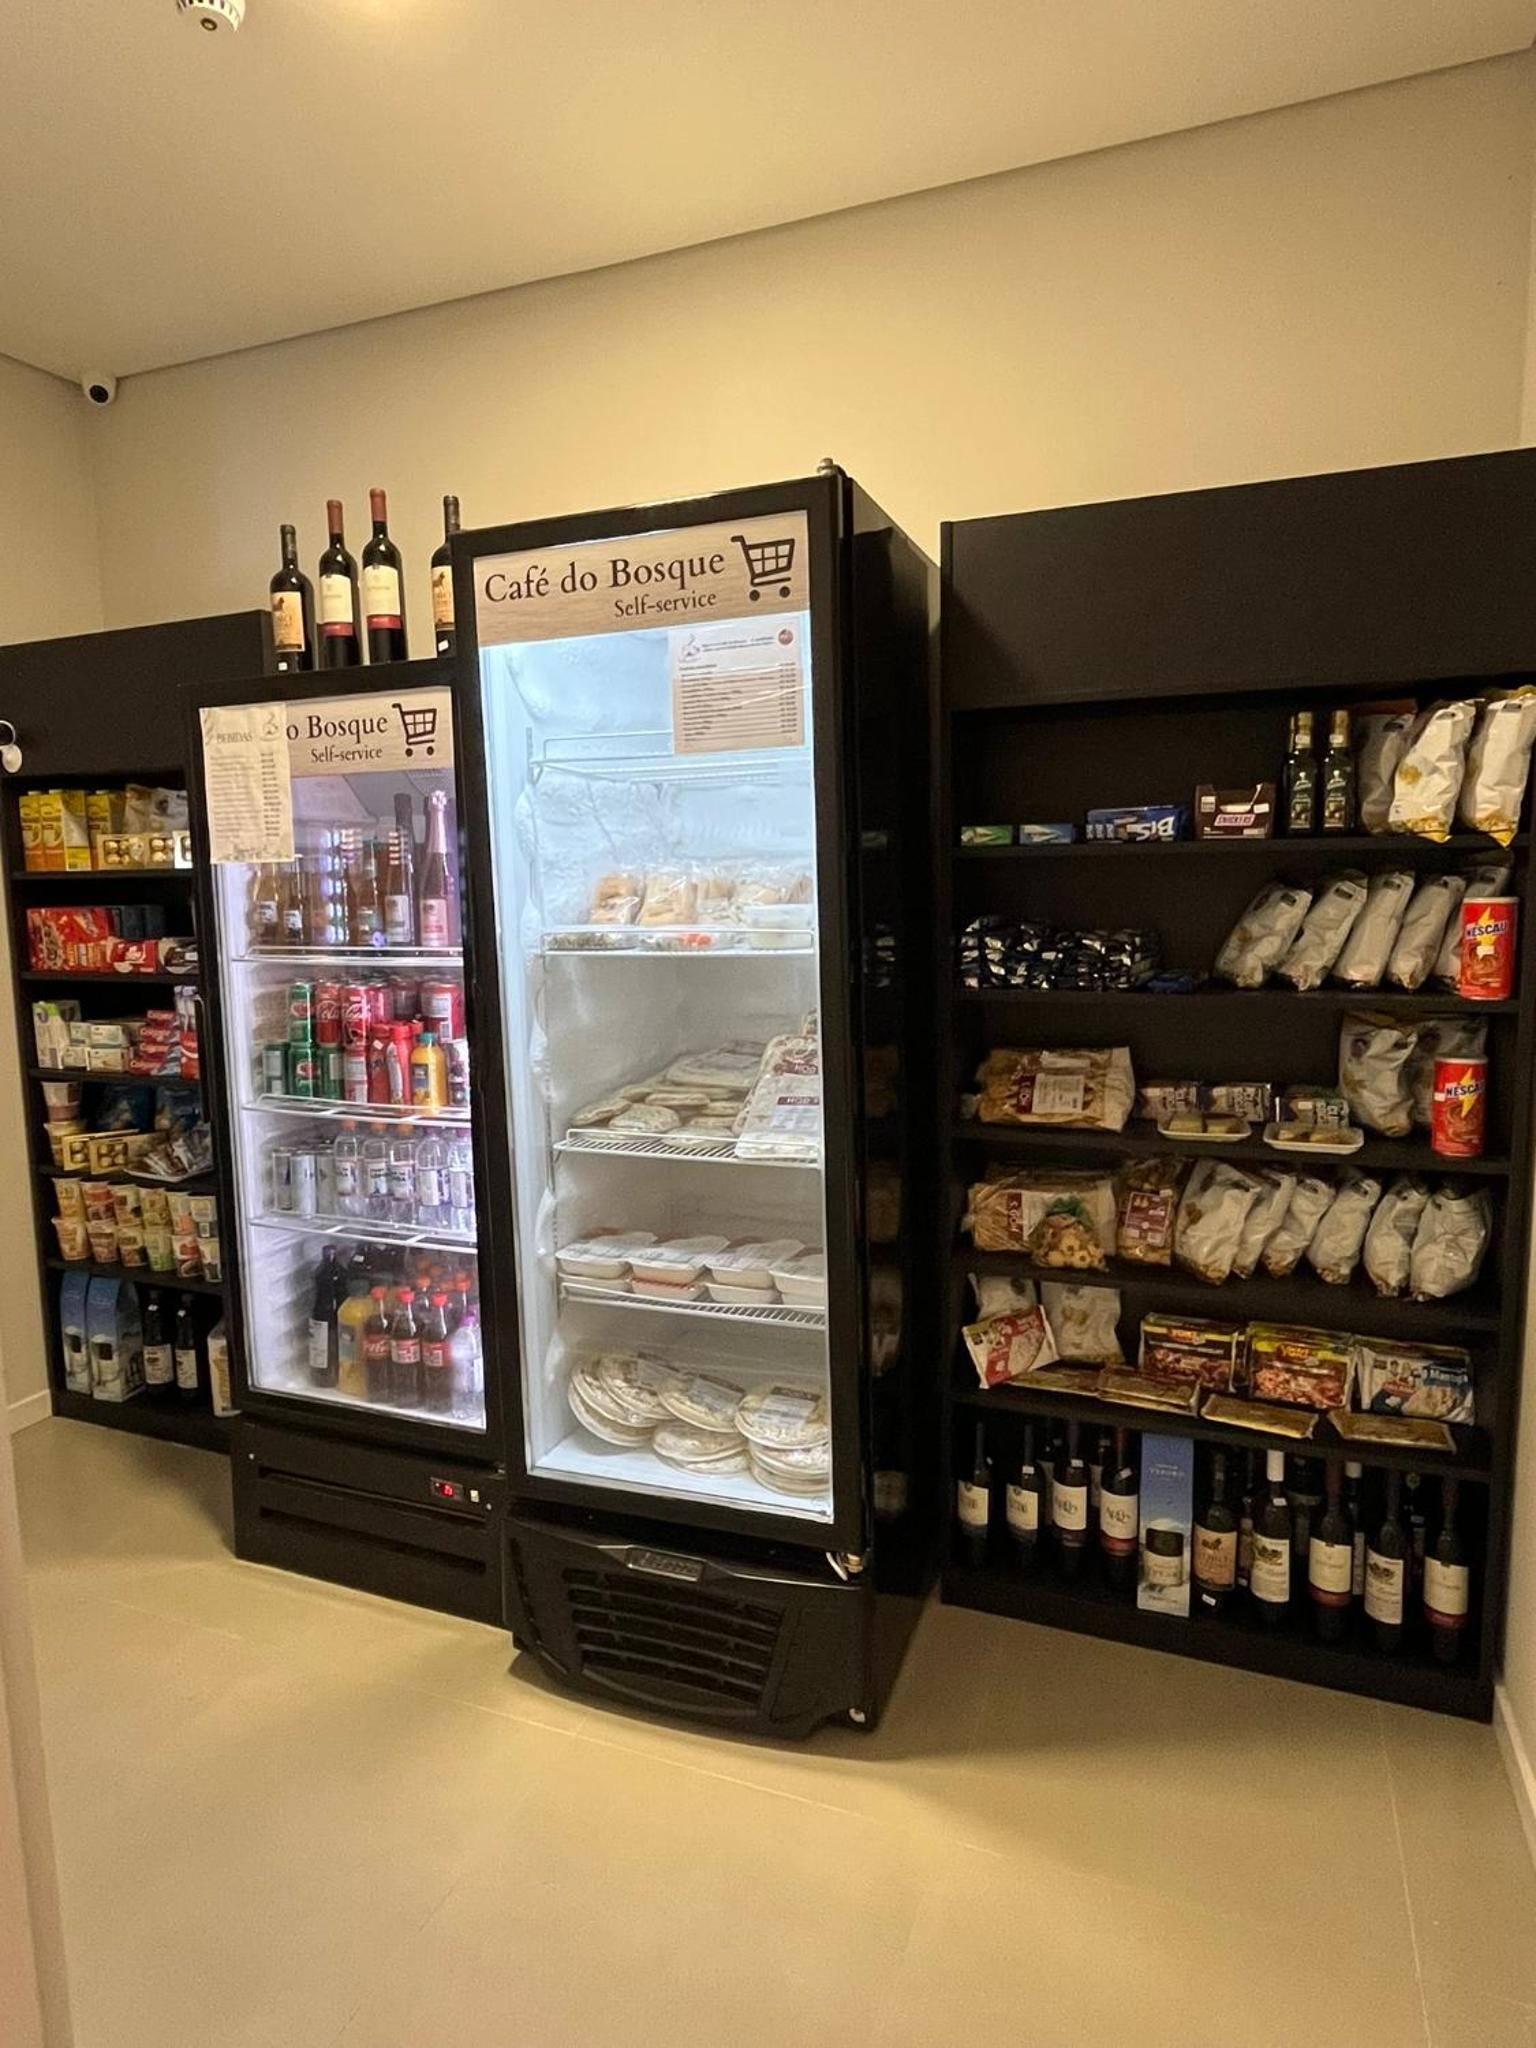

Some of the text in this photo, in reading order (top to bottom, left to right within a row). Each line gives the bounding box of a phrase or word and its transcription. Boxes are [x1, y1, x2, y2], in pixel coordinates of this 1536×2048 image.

[485, 553, 725, 602] Café do Bosque
[615, 590, 717, 618] Self-service
[306, 714, 388, 744] Bosque
[311, 746, 382, 764] Self-service
[1445, 1082, 1484, 1097] NESCA
